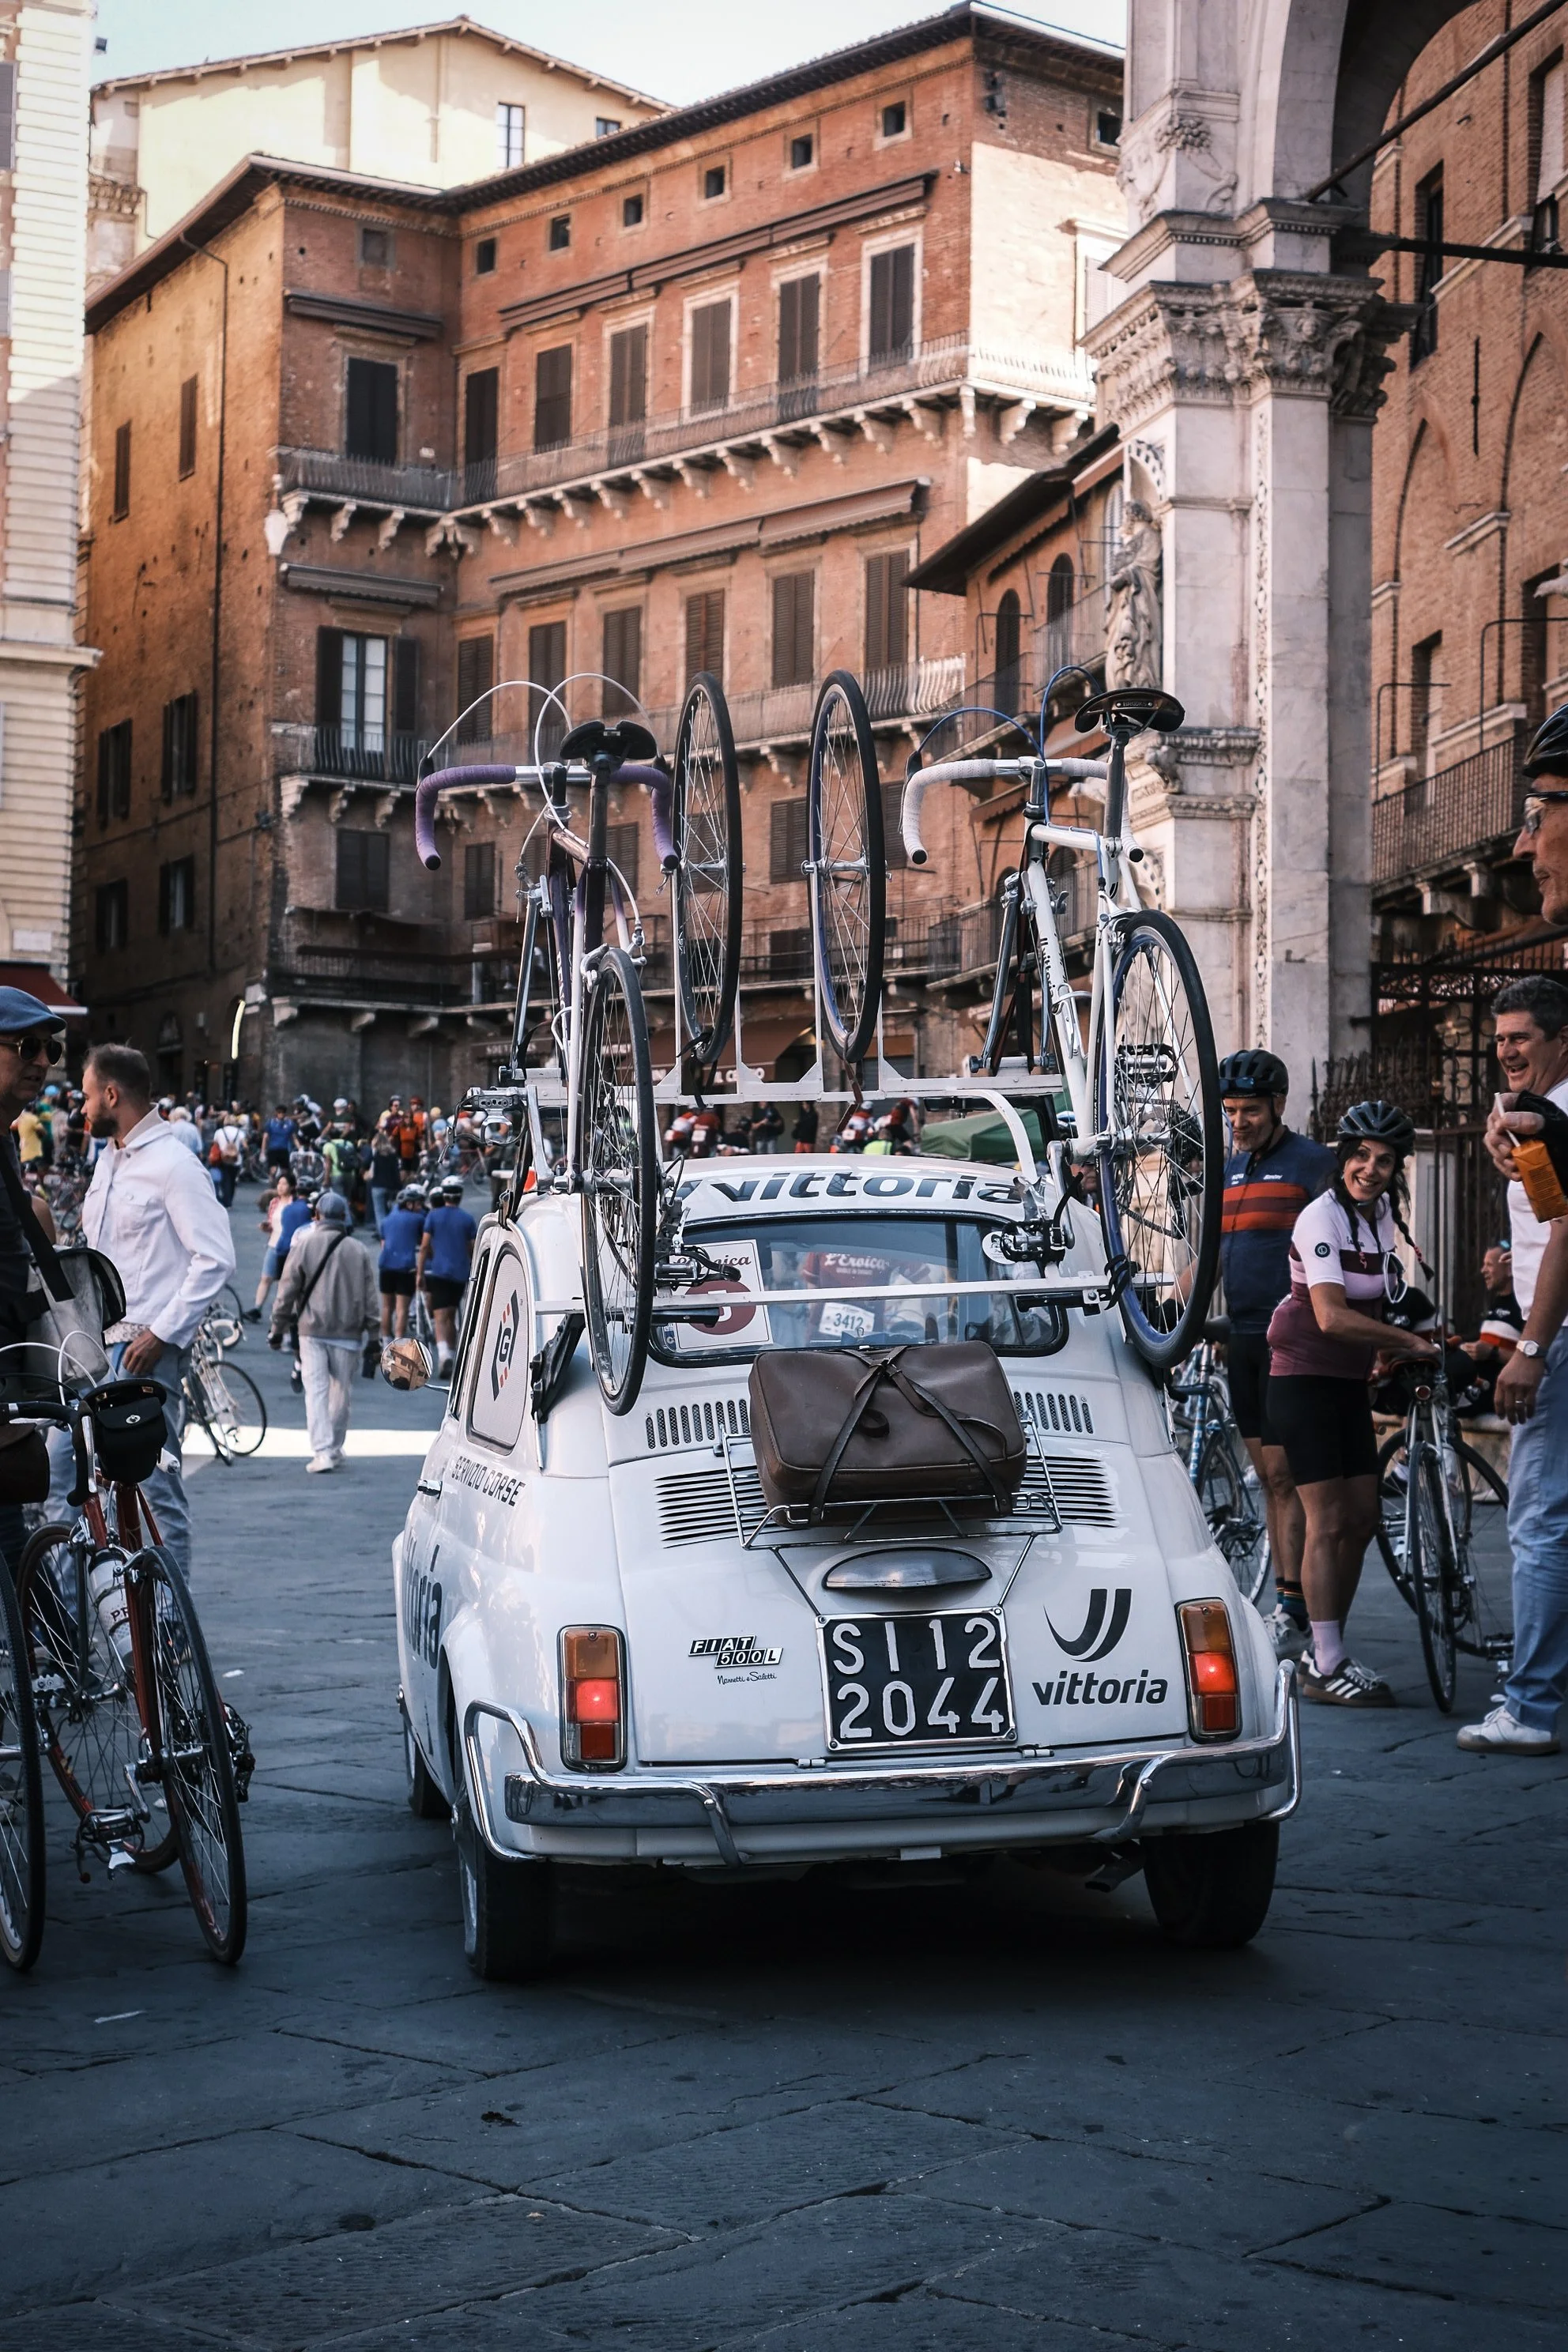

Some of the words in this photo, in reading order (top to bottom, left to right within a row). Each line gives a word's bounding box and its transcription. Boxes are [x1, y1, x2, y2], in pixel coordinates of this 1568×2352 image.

[710, 1172, 1023, 1204] vittoria
[834, 1313, 864, 1332] 3412
[451, 1456, 488, 1490] SERVIZIO
[482, 1470, 526, 1506] CORSE
[693, 1637, 752, 1653] FIAT
[1031, 1669, 1168, 1706] vittoria
[837, 1676, 1004, 1739] 2044
